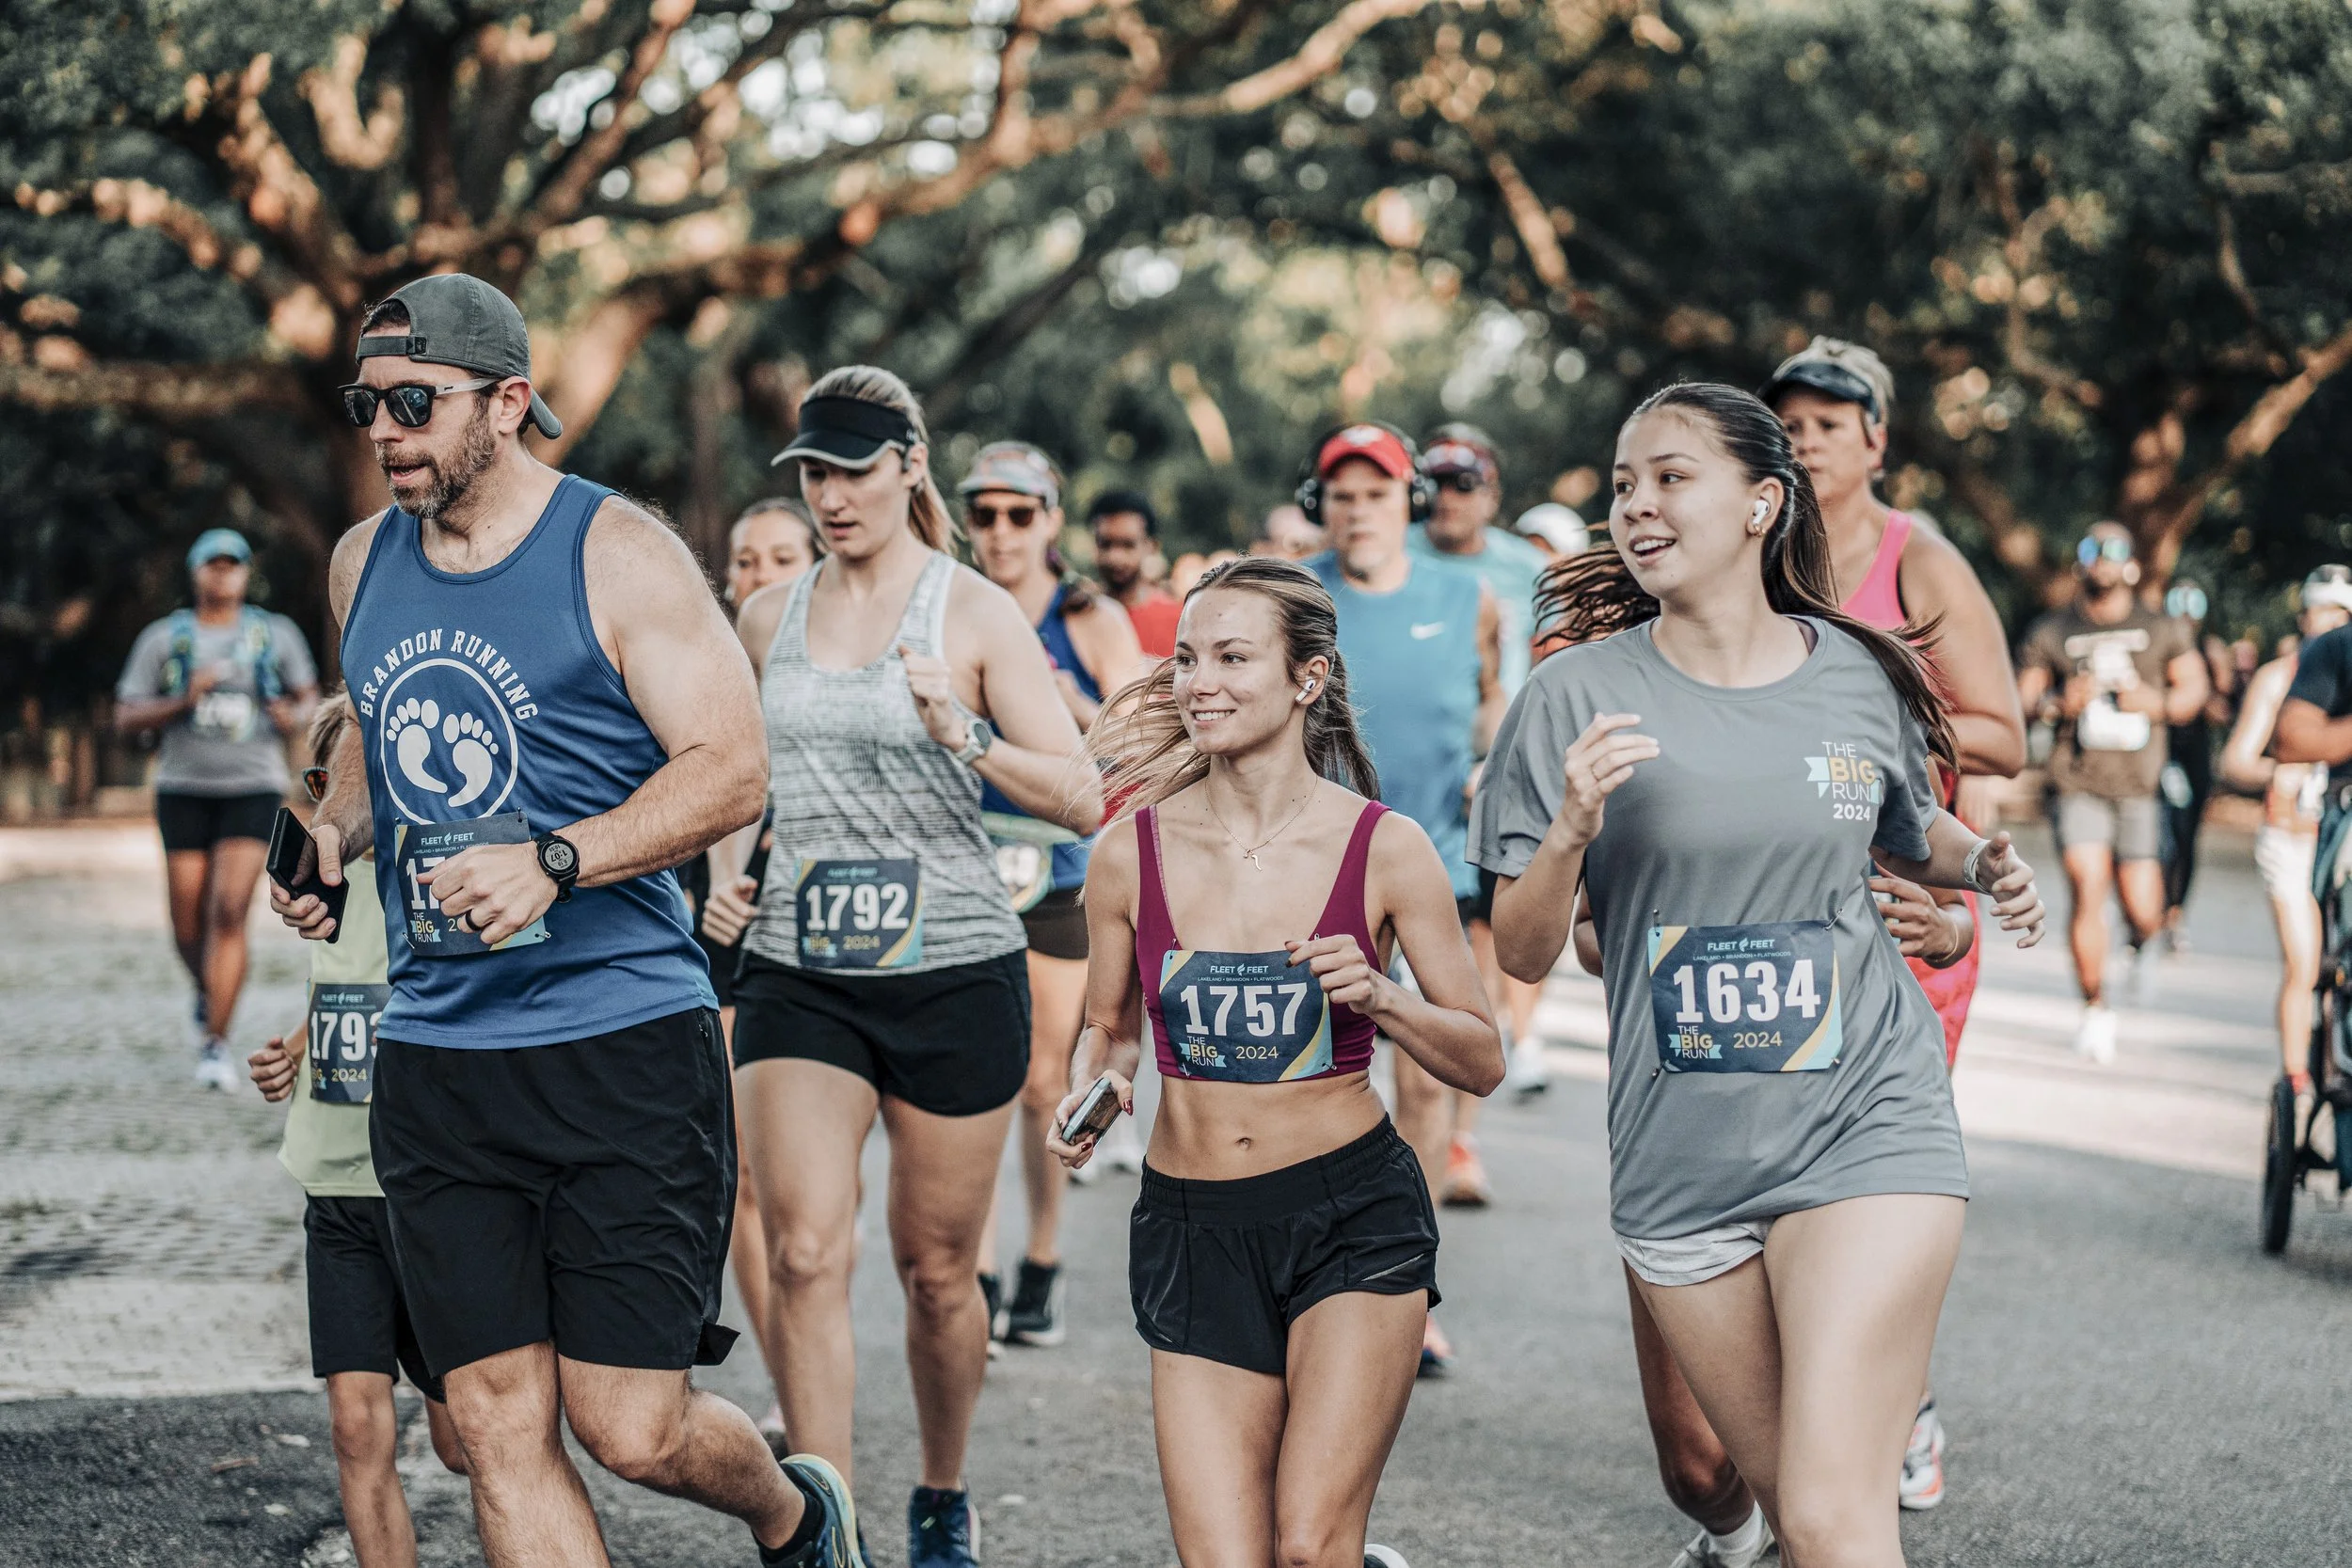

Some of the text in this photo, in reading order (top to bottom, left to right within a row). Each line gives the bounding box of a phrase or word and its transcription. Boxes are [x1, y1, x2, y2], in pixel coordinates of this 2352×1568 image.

[360, 628, 443, 718] BRANDON
[450, 629, 538, 721] RUNNING
[1821, 741, 1857, 758] THE
[1828, 756, 1876, 784] BIG
[1832, 782, 1871, 802] RUN
[1833, 803, 1871, 821] 2024
[421, 832, 474, 846] FLEET FEET
[405, 856, 445, 910] 17
[805, 882, 910, 931] 1792
[413, 911, 425, 921] THE
[416, 920, 435, 933] BIG
[418, 933, 433, 942] RUN
[1707, 939, 1775, 951] FLEET FEET
[1210, 965, 1269, 974] FLEET FEET
[1673, 958, 1821, 1023] 1634
[1180, 982, 1308, 1037] 1757
[1677, 1025, 1699, 1035] THE
[1187, 1036, 1206, 1045] THE
[1681, 1034, 1713, 1050] BIG
[1733, 1031, 1783, 1049] 2024
[1189, 1044, 1218, 1058] BIG
[1235, 1046, 1279, 1060] 2024
[1682, 1049, 1708, 1059] RUN
[1192, 1056, 1215, 1067] RUN
[331, 1068, 367, 1083] 2024
